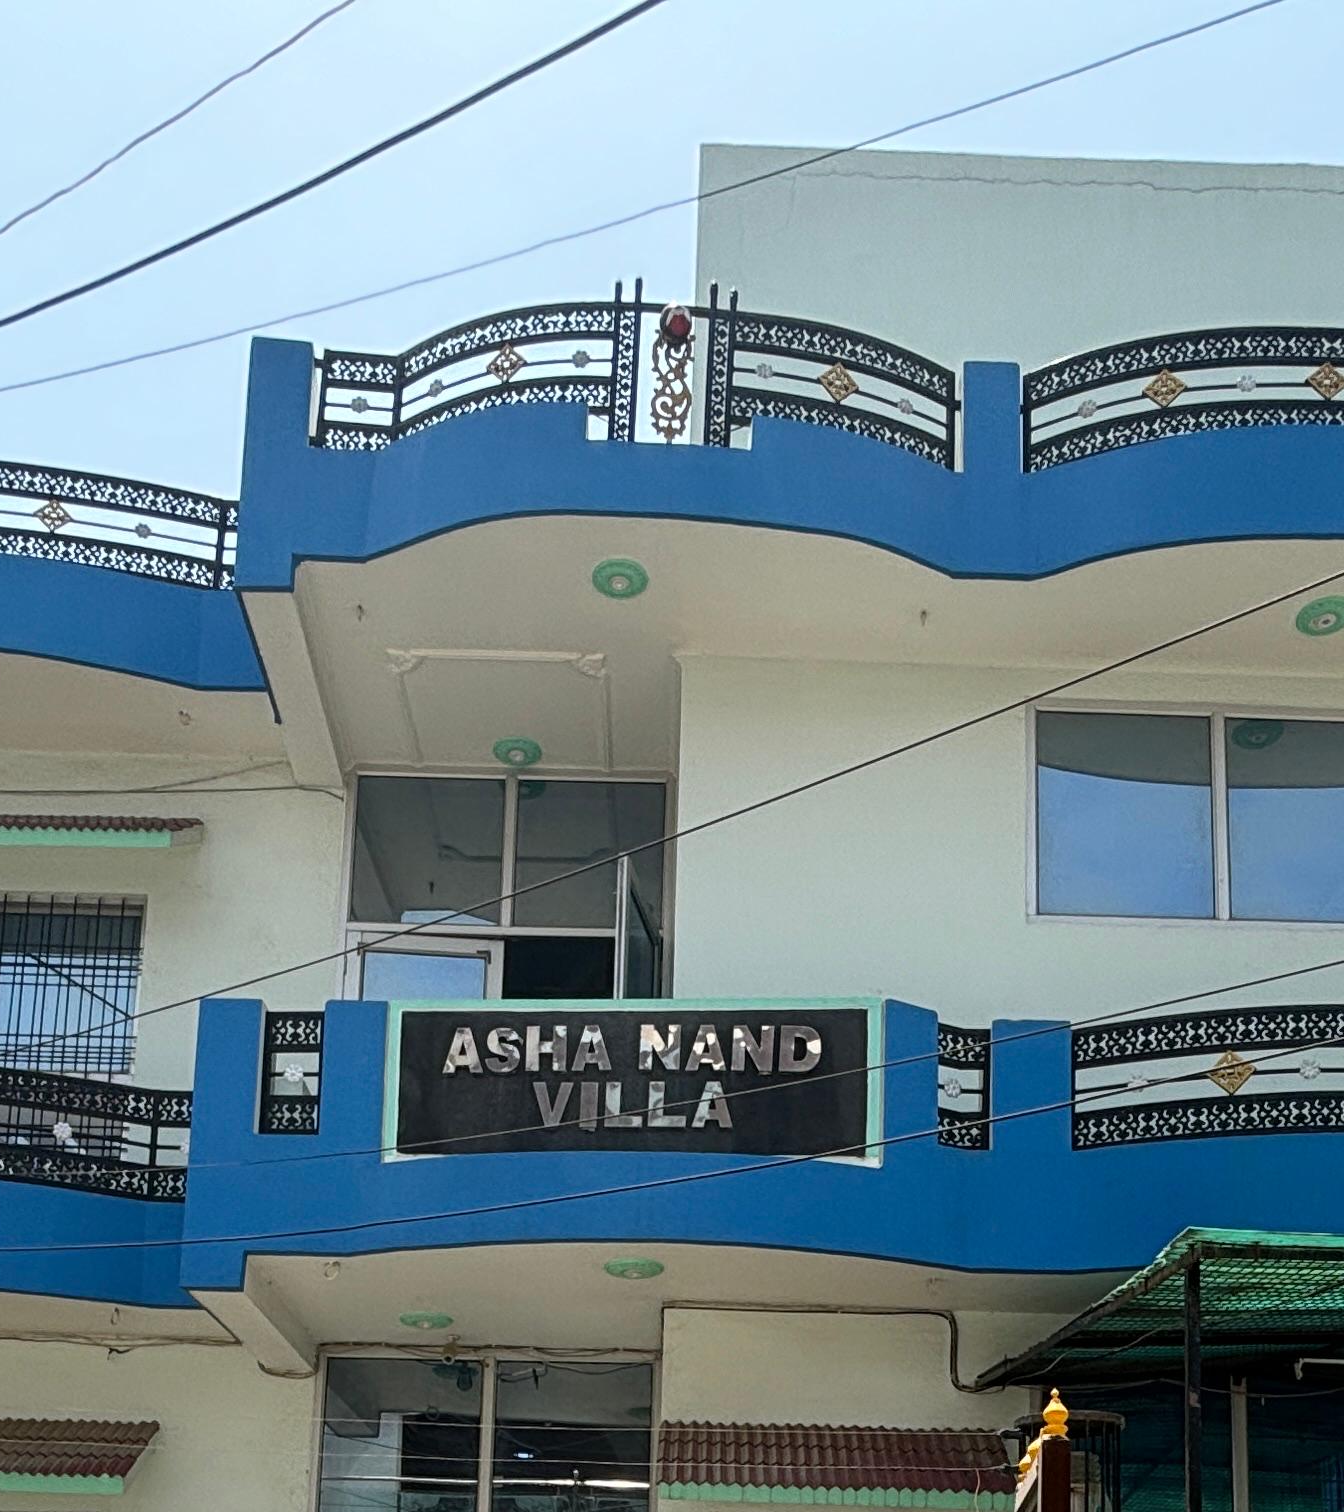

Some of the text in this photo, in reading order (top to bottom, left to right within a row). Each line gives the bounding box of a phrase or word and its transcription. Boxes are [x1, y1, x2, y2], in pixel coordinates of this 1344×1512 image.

[442, 1024, 822, 1073] ASHA NAND
[532, 1081, 733, 1129] VILLA
